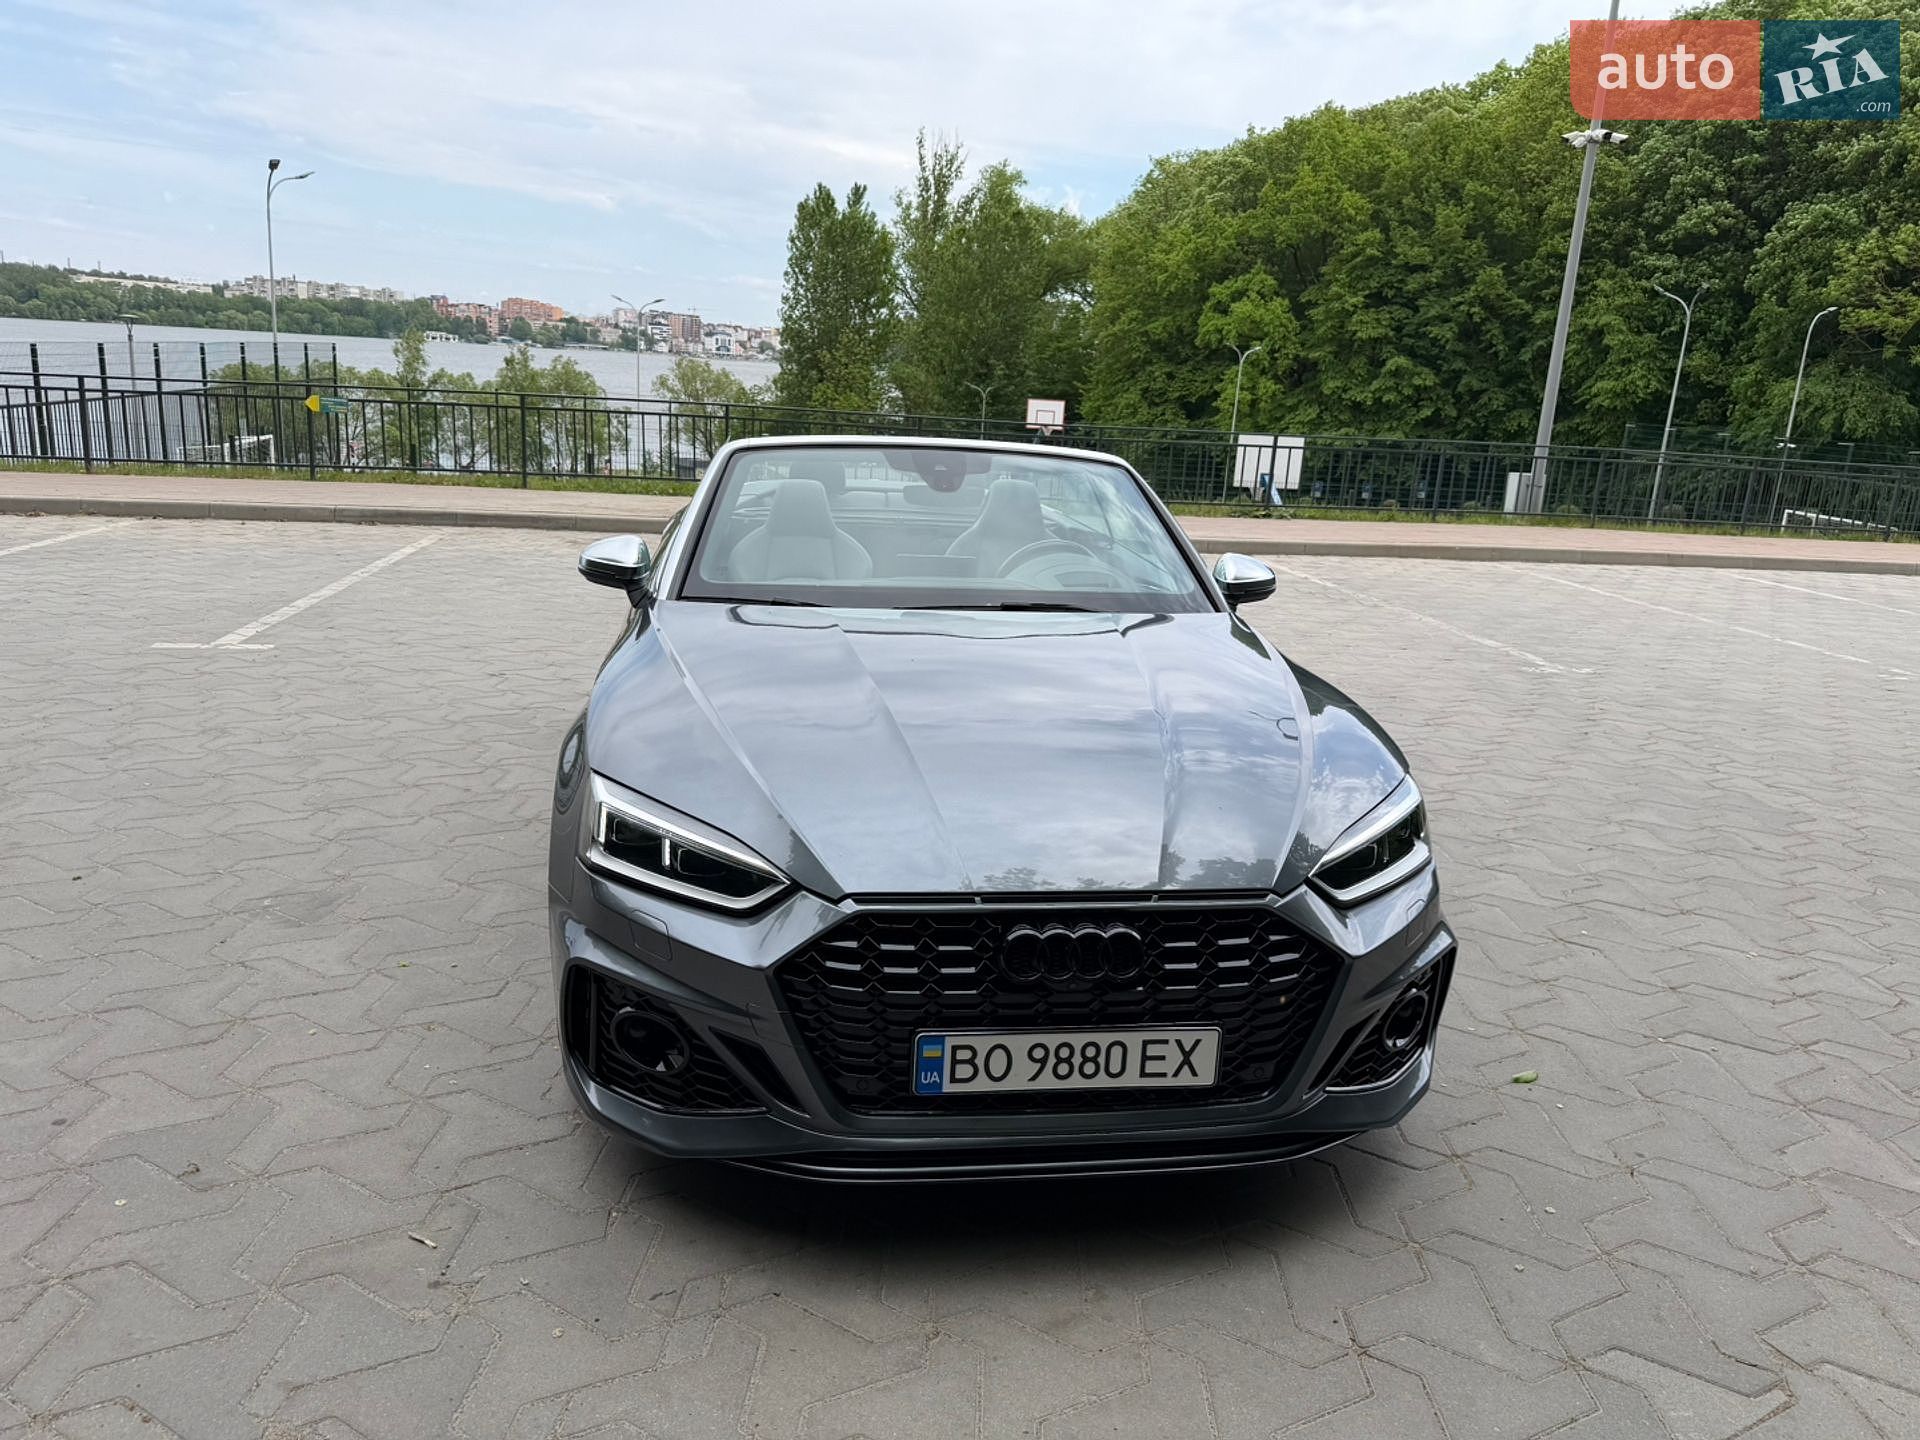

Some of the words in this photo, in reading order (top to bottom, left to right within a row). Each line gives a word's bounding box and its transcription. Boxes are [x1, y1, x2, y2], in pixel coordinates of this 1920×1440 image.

[950, 1044, 1013, 1084] BO
[1027, 1040, 1128, 1082] 9880
[1139, 1038, 1202, 1079] EX
[921, 1071, 940, 1085] UA
